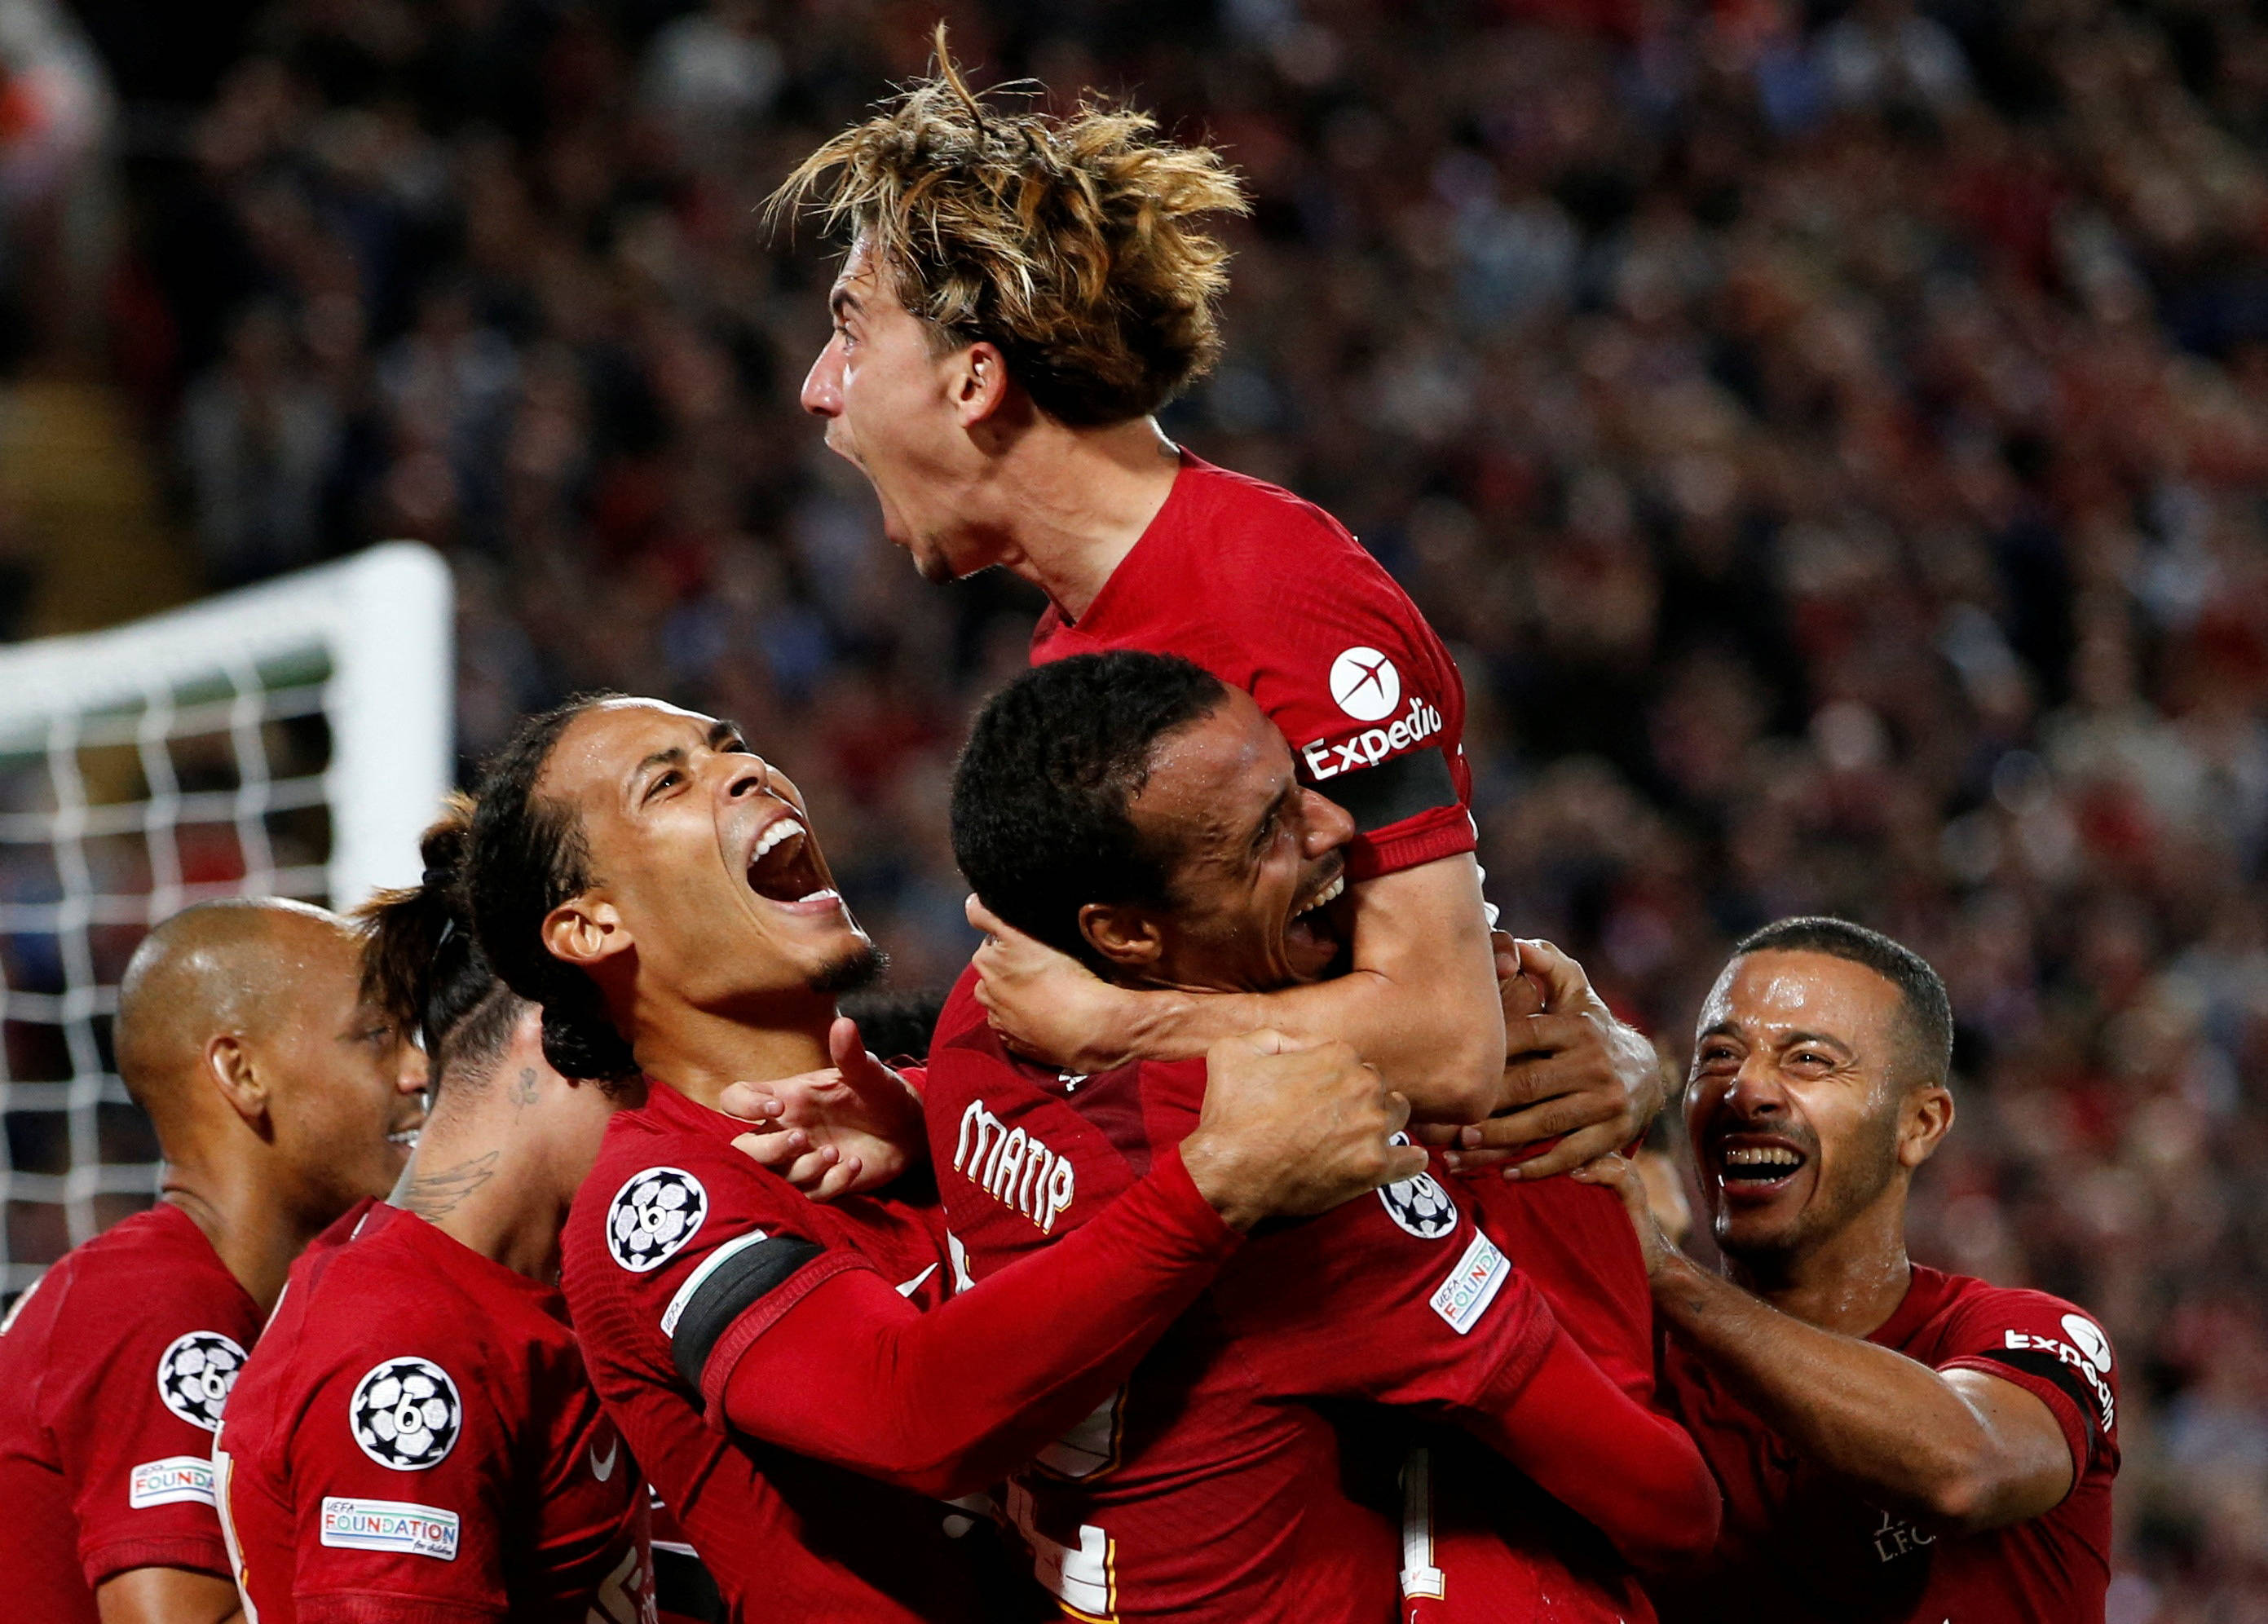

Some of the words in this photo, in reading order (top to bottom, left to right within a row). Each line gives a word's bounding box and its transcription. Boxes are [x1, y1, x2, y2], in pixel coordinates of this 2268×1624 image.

[954, 1099, 1074, 1234] MATIP
[638, 1201, 667, 1233] 6
[1436, 1278, 1460, 1308] UEFA
[201, 1362, 227, 1401] 6
[393, 1392, 424, 1435] 6
[327, 1501, 355, 1513] UEFA
